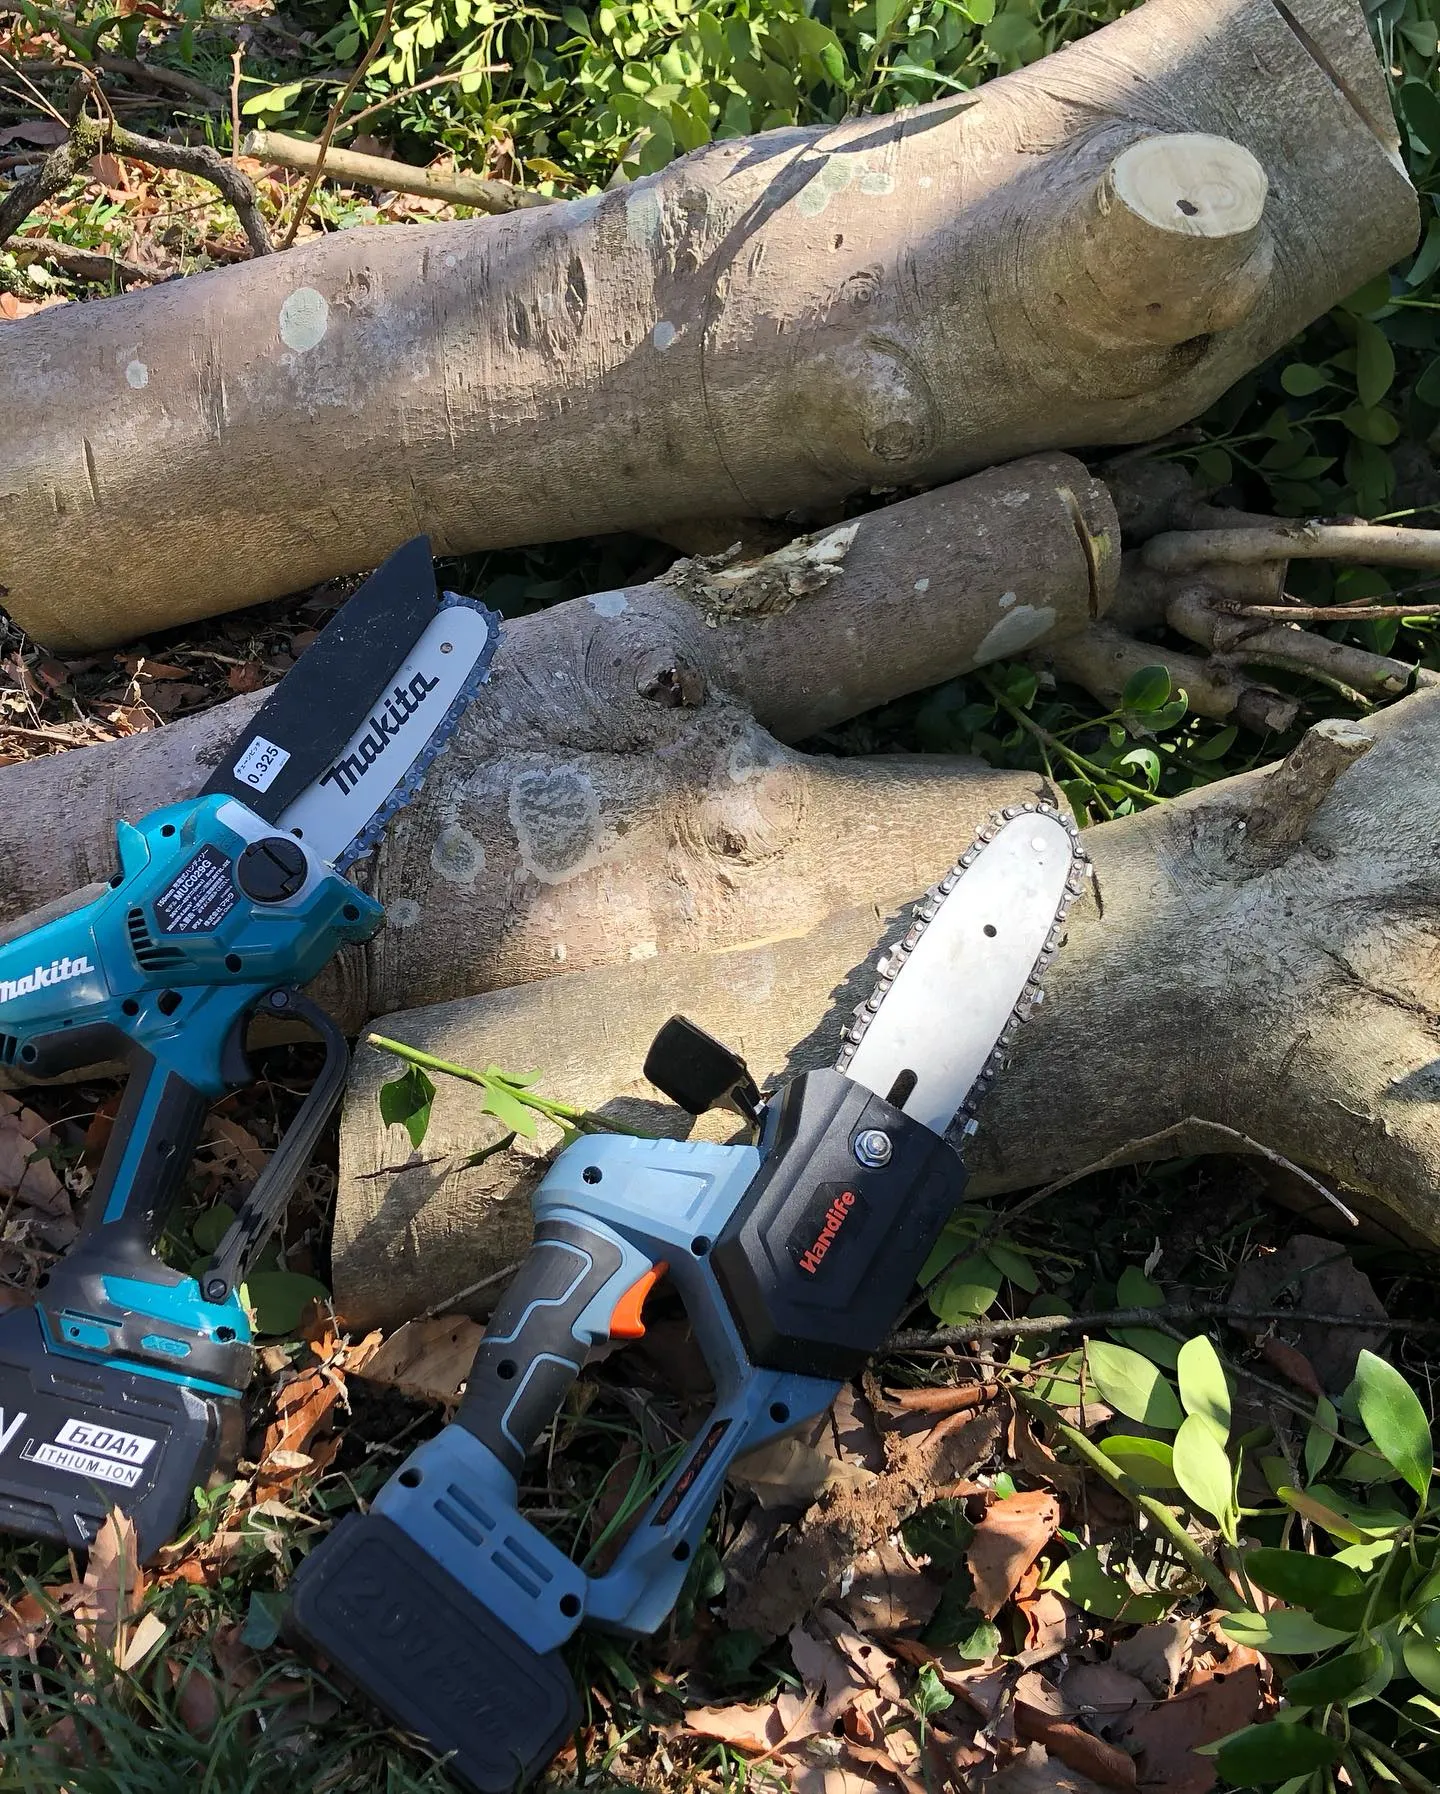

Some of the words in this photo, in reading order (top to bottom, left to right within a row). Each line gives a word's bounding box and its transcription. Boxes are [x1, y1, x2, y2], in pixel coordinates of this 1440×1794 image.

[319, 672, 440, 796] makita
[247, 746, 278, 784] 0.325
[172, 859, 212, 901] MUC029G
[19, 1438, 138, 1483] LITHIUM-ION
[69, 1425, 140, 1458] 6.0Ah
